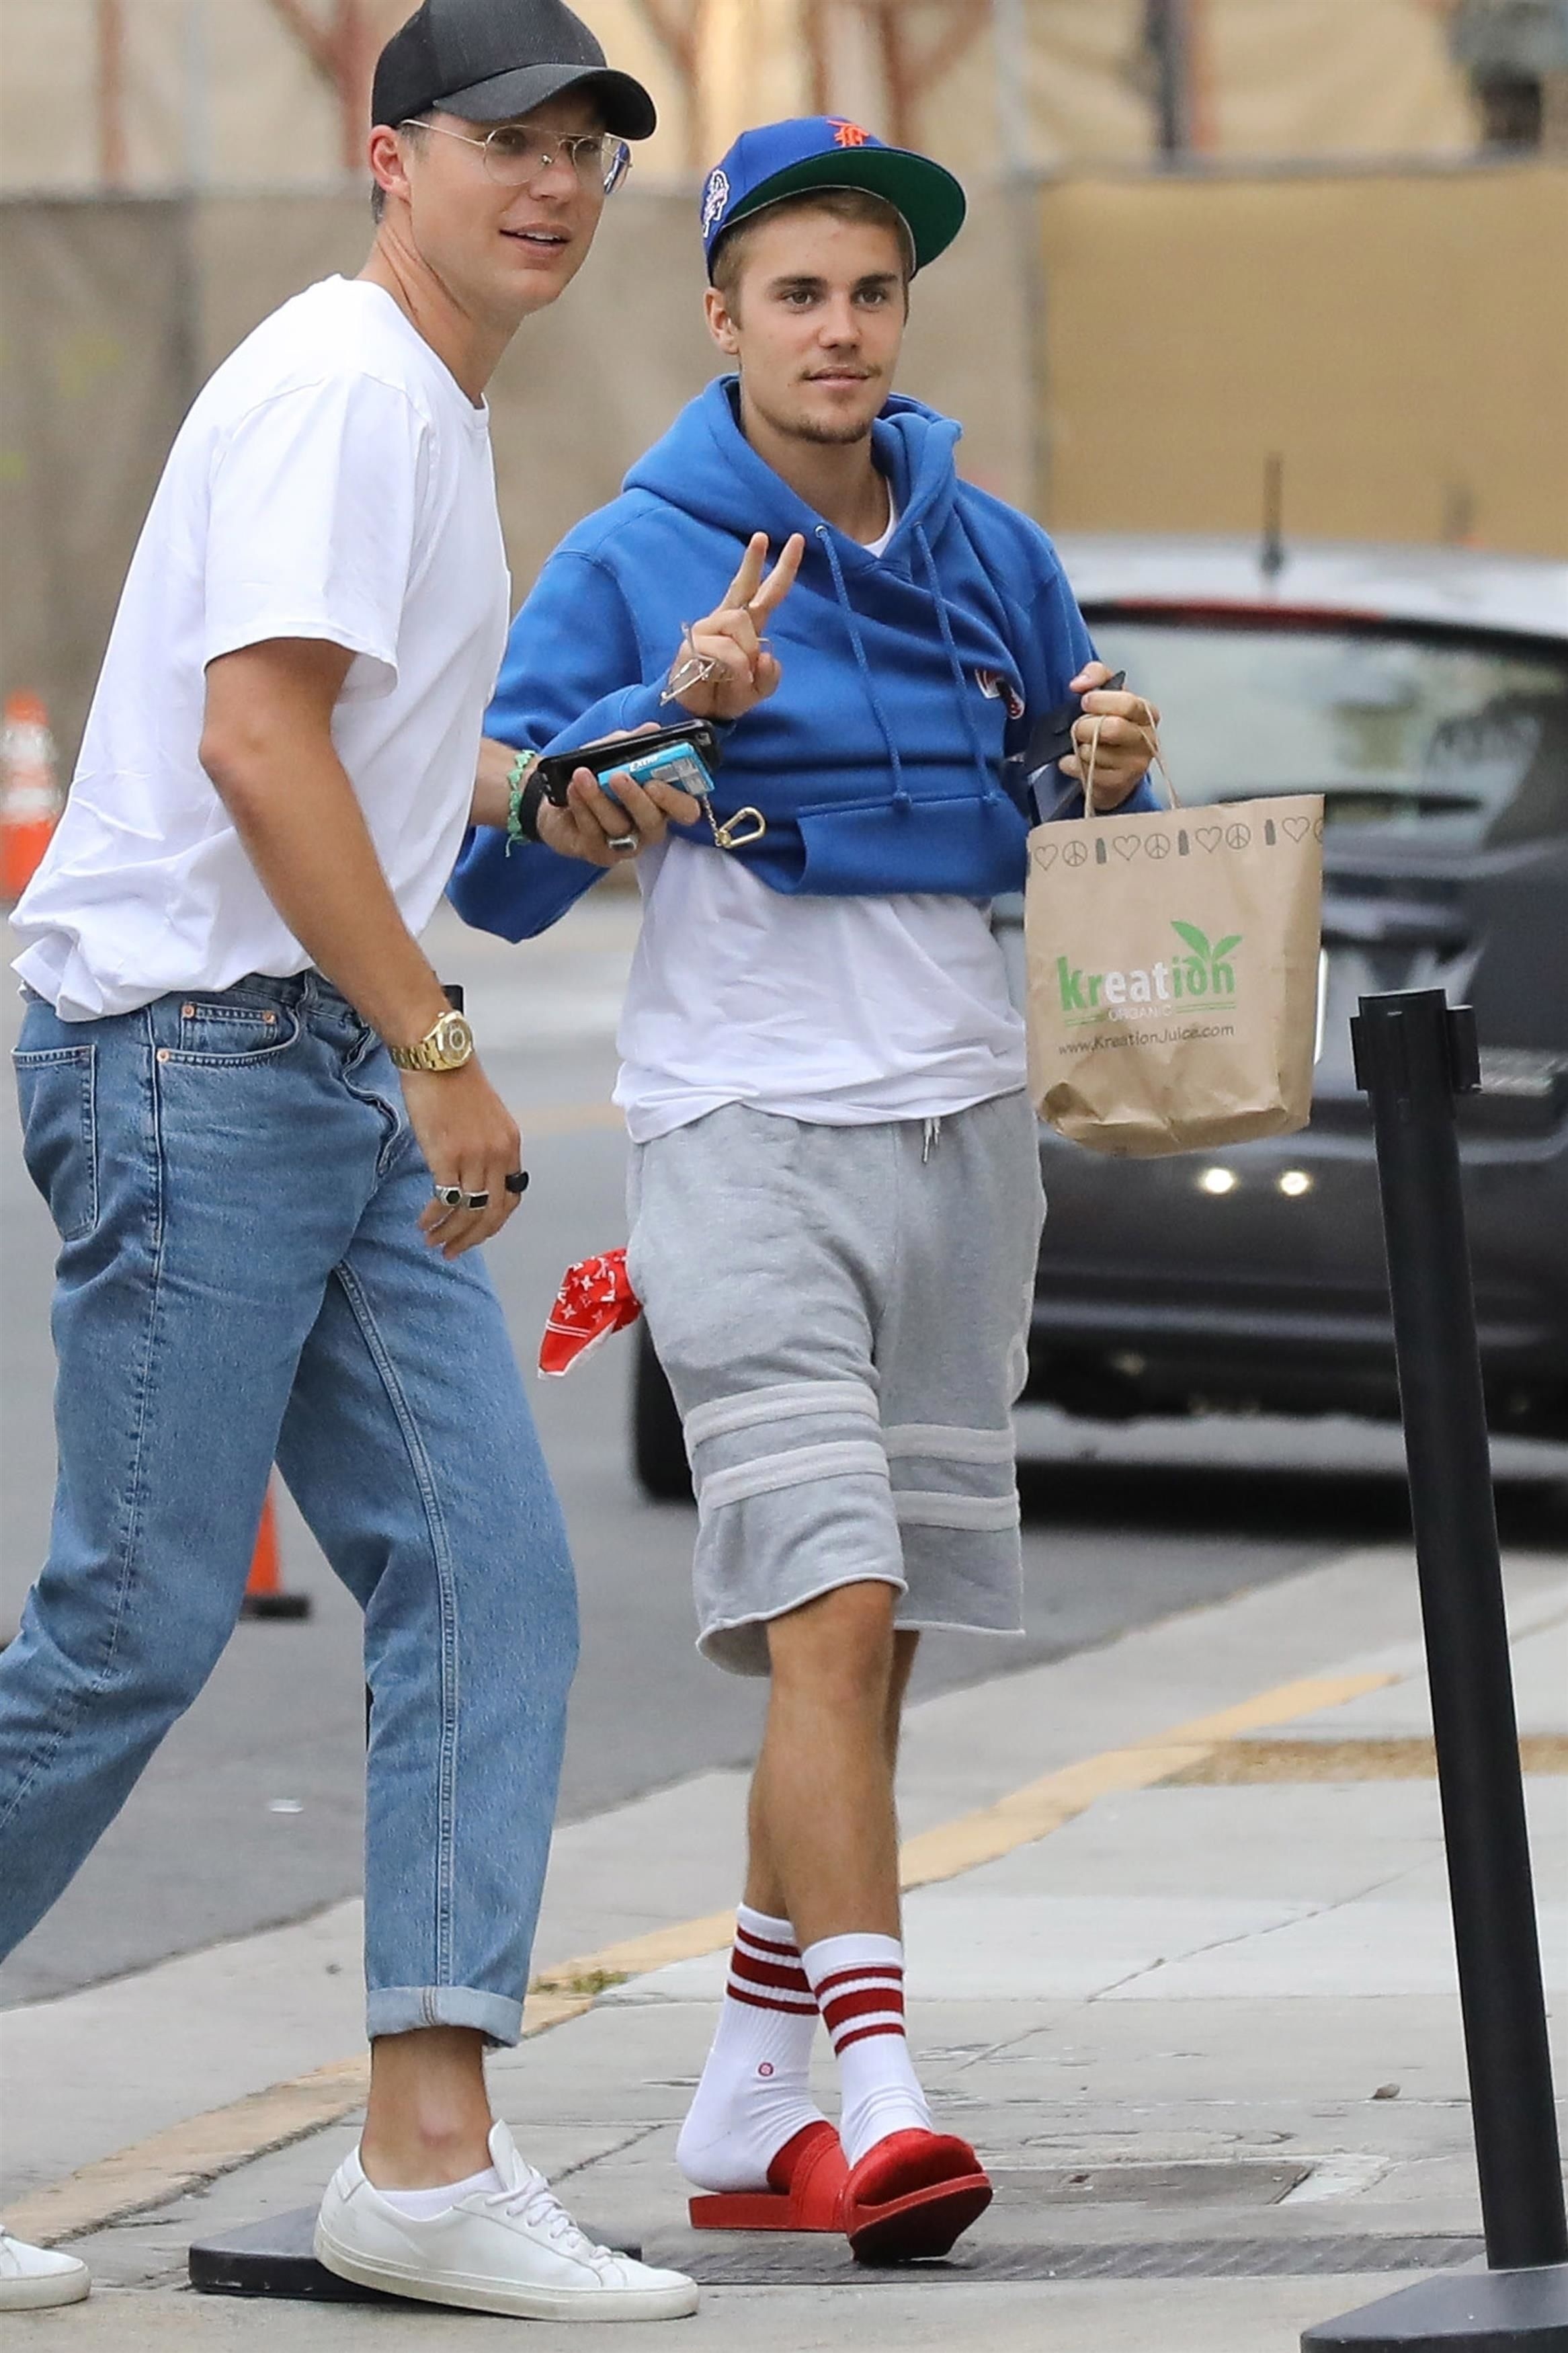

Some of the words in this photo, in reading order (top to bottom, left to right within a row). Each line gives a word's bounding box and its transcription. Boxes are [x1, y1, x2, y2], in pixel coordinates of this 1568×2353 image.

[1057, 955, 1235, 1010] kreation
[1108, 1004, 1172, 1022] ORGANIC
[1059, 1024, 1234, 1055] www.KreationJuice.com
